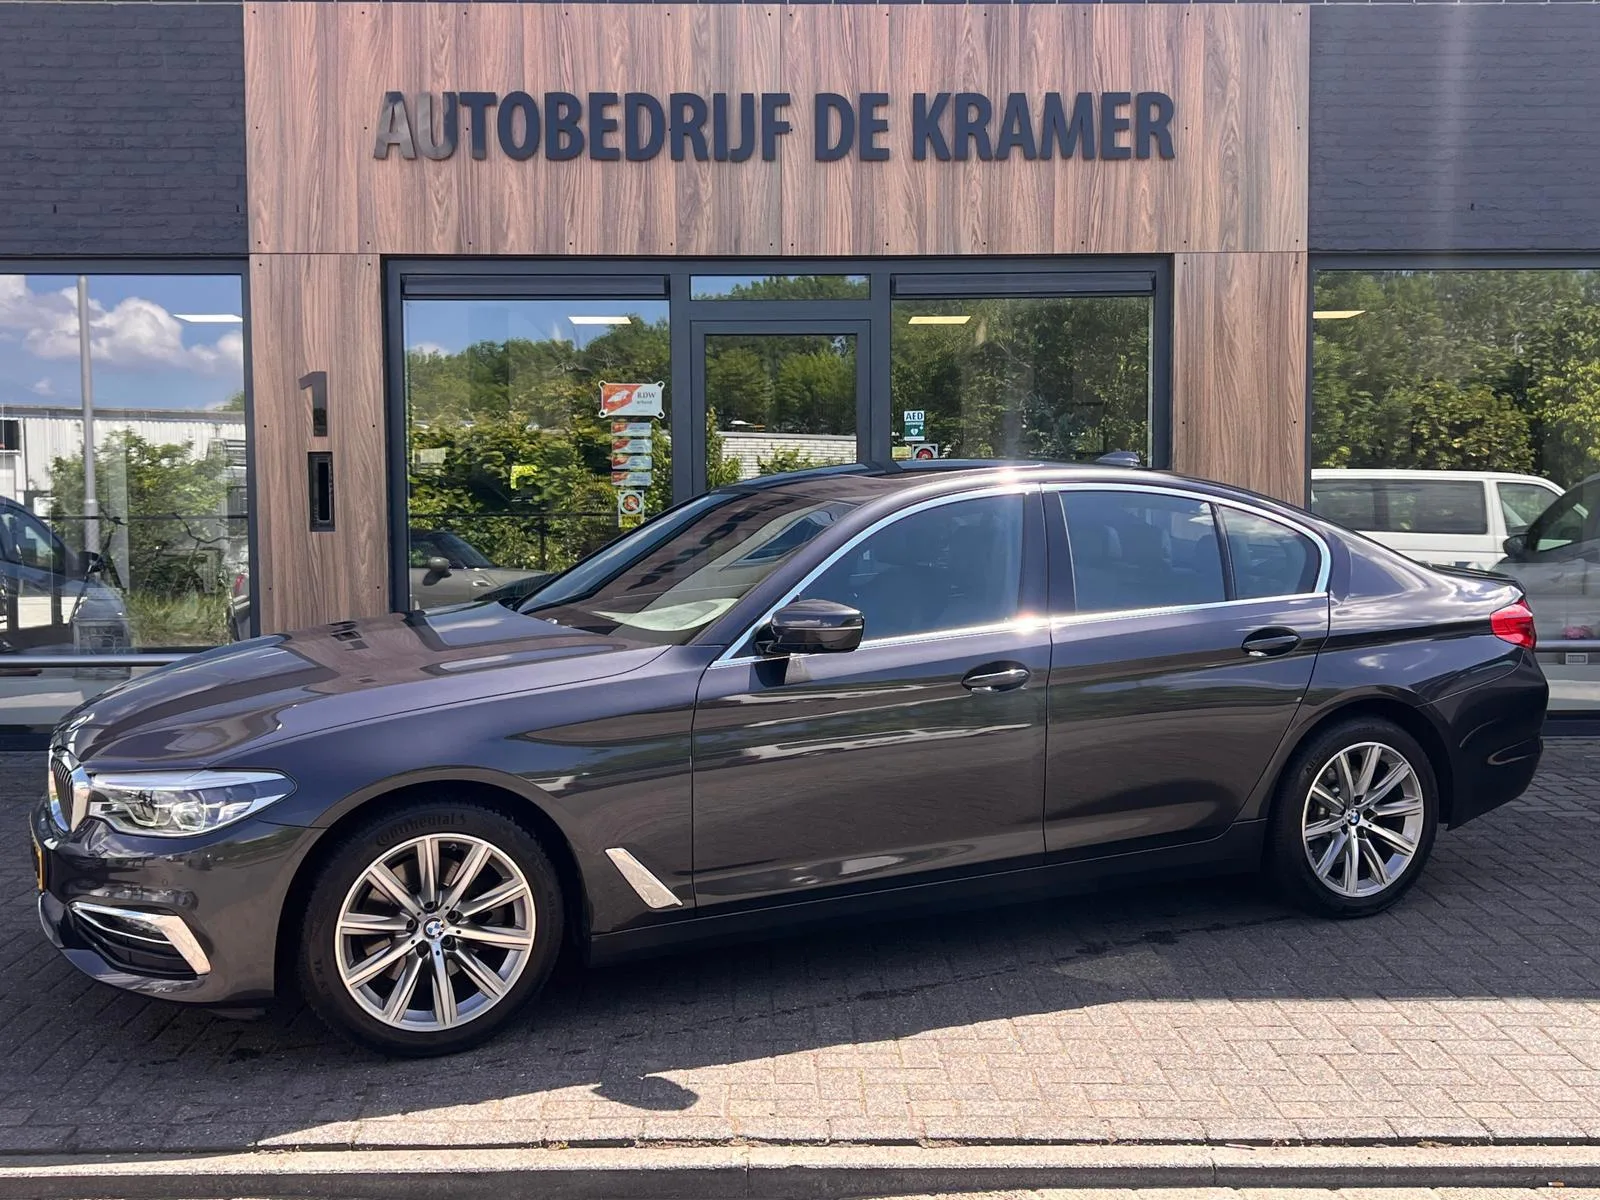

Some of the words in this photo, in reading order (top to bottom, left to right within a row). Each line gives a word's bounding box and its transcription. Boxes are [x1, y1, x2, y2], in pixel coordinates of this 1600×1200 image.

[373, 91, 791, 162] AUTOBEDRIJF
[814, 92, 890, 162] DE
[912, 91, 1176, 161] KRAMER
[298, 371, 327, 437] 1
[905, 412, 923, 420] AED
